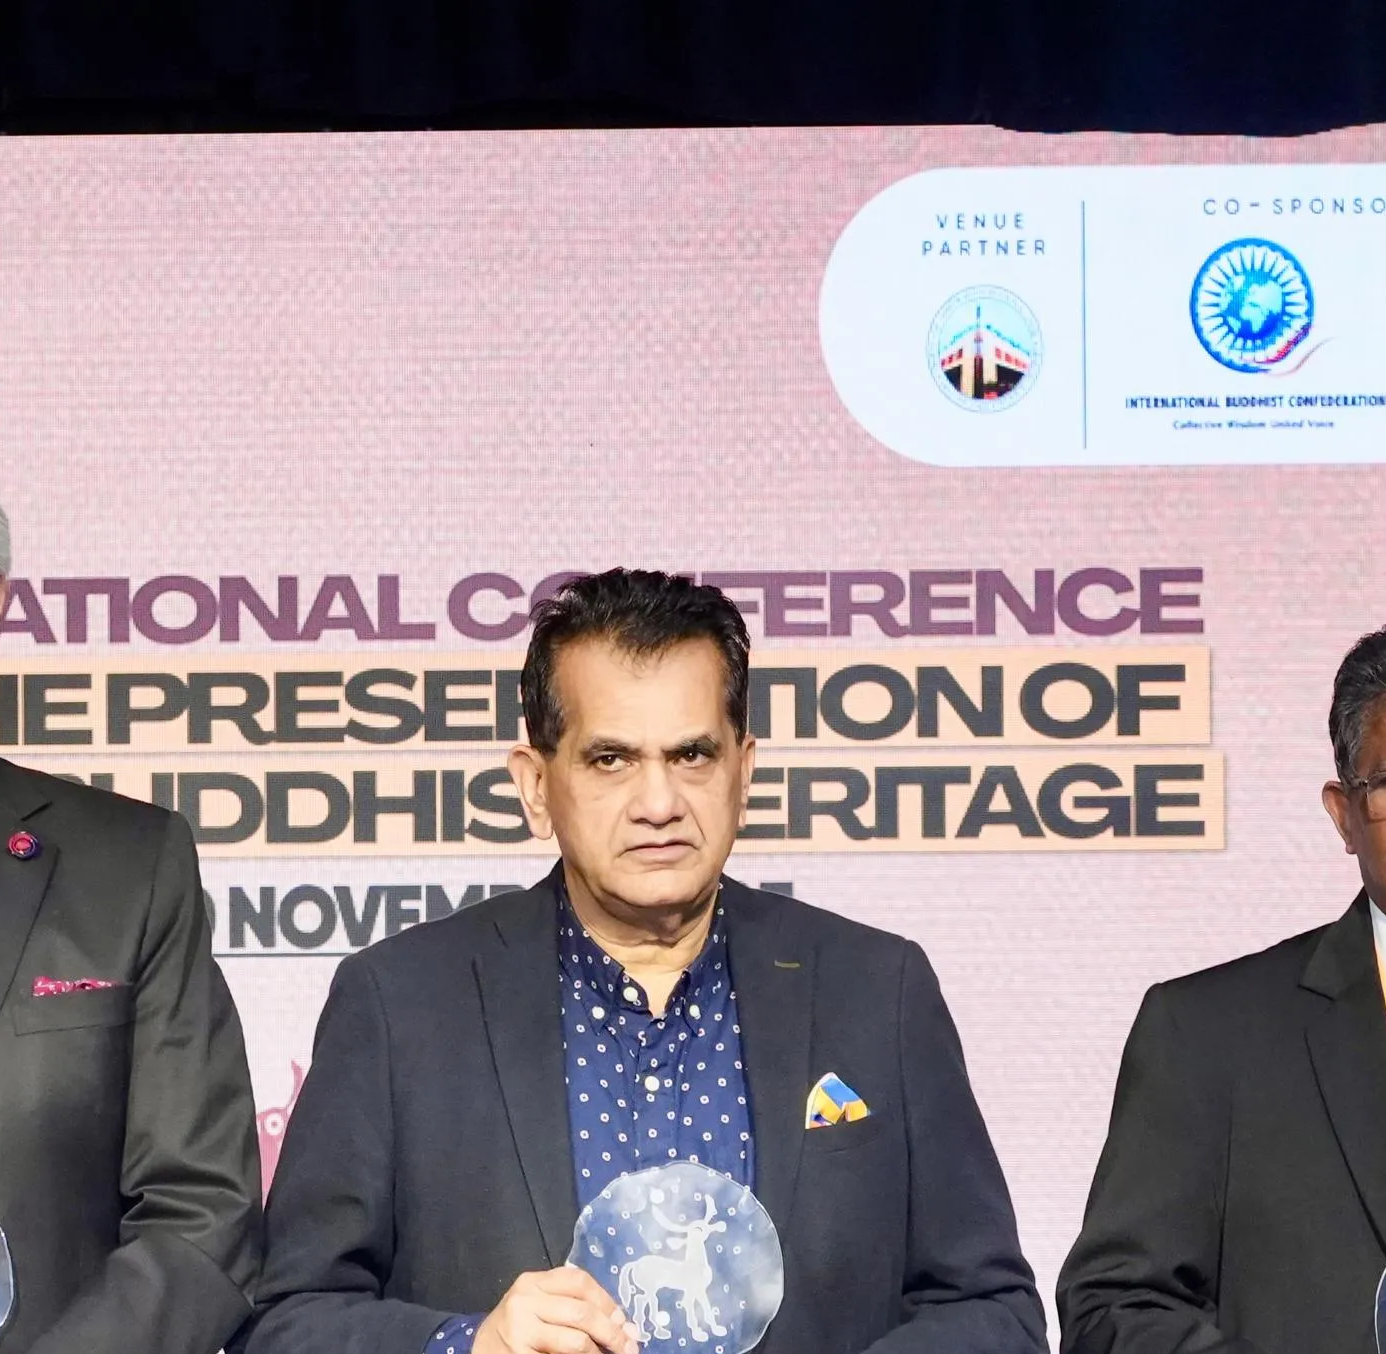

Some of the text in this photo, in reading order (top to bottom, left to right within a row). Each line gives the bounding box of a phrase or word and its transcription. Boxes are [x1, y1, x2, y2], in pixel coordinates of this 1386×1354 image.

[936, 213, 1026, 230] VENUE
[921, 240, 1047, 256] PARTNER
[1125, 396, 1221, 409] INTERNATIONAL
[1226, 396, 1284, 408] BUDDHIST
[447, 569, 1204, 642] CFERENCE
[106, 664, 1004, 745] PRESETION
[1019, 662, 1186, 739] OF
[737, 763, 1205, 841] ERITAGE
